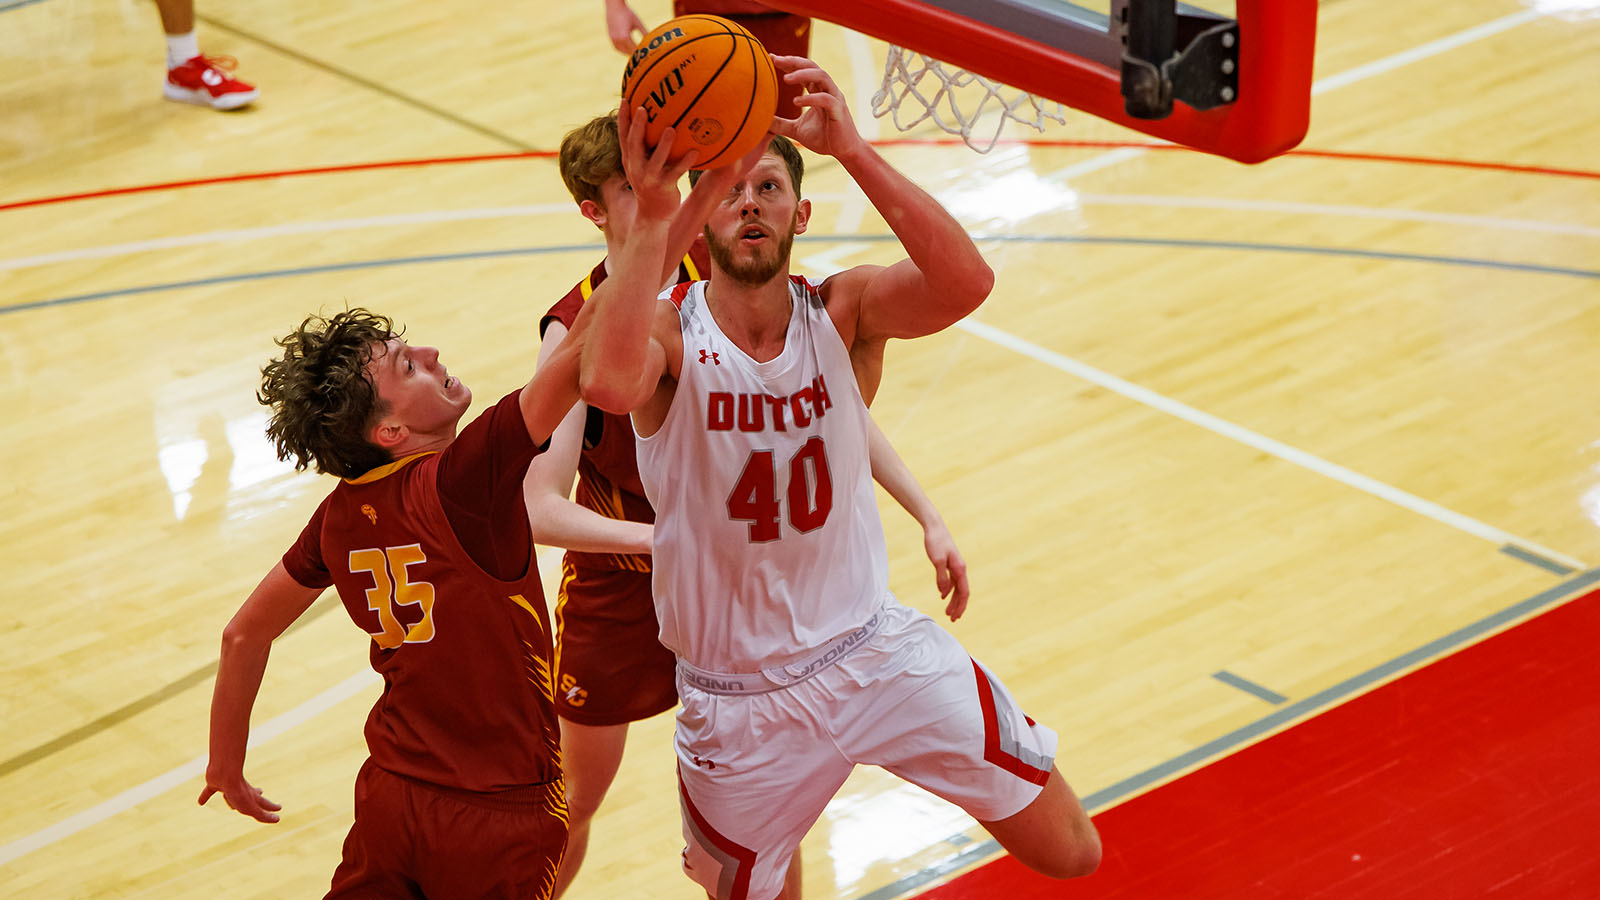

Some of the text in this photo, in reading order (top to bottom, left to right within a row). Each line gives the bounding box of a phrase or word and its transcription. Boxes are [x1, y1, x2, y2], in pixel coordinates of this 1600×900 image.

[707, 374, 833, 433] DUTCH
[725, 435, 834, 544] 40
[348, 543, 436, 650] 35
[680, 665, 744, 691] UNDE
